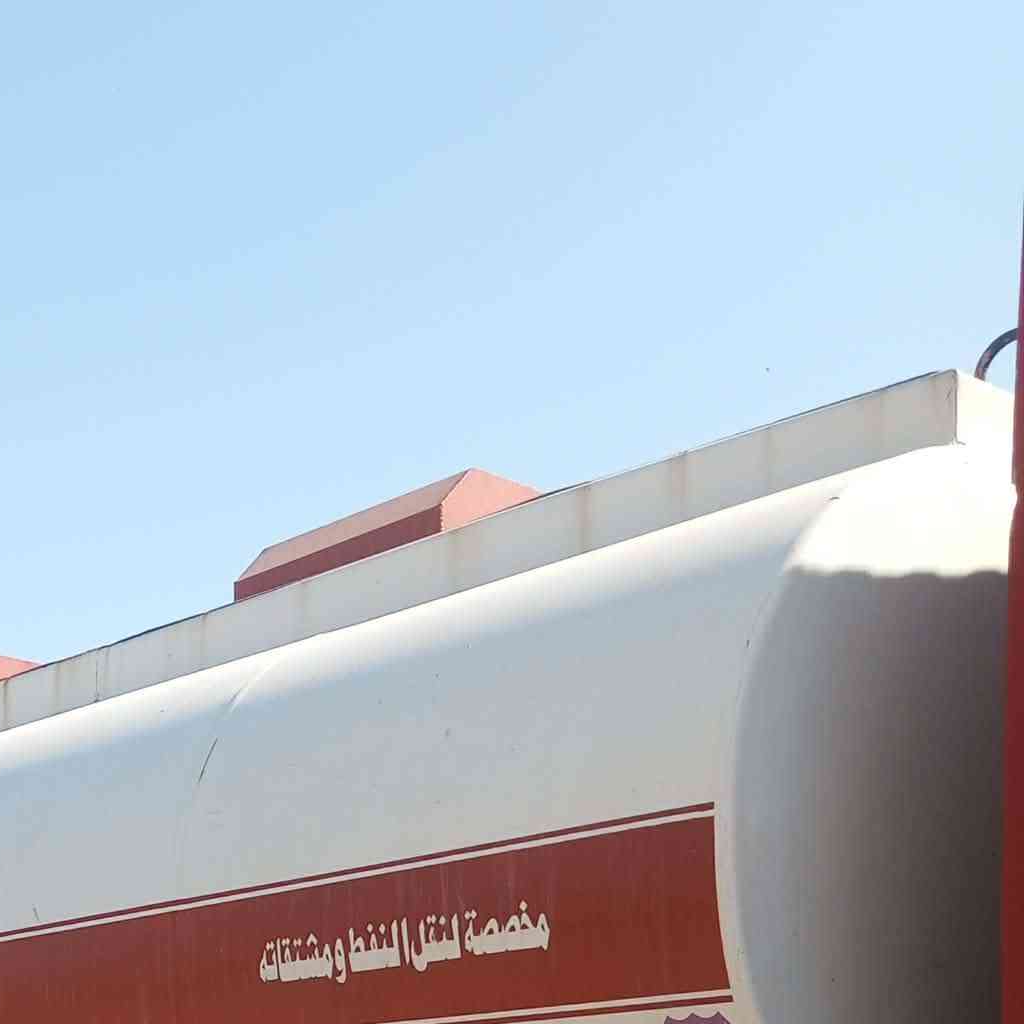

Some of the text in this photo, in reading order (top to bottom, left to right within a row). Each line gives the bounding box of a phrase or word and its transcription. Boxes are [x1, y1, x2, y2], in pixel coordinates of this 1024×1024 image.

[259, 900, 550, 984] مخصصة لنقل النفط ومشتقاته
